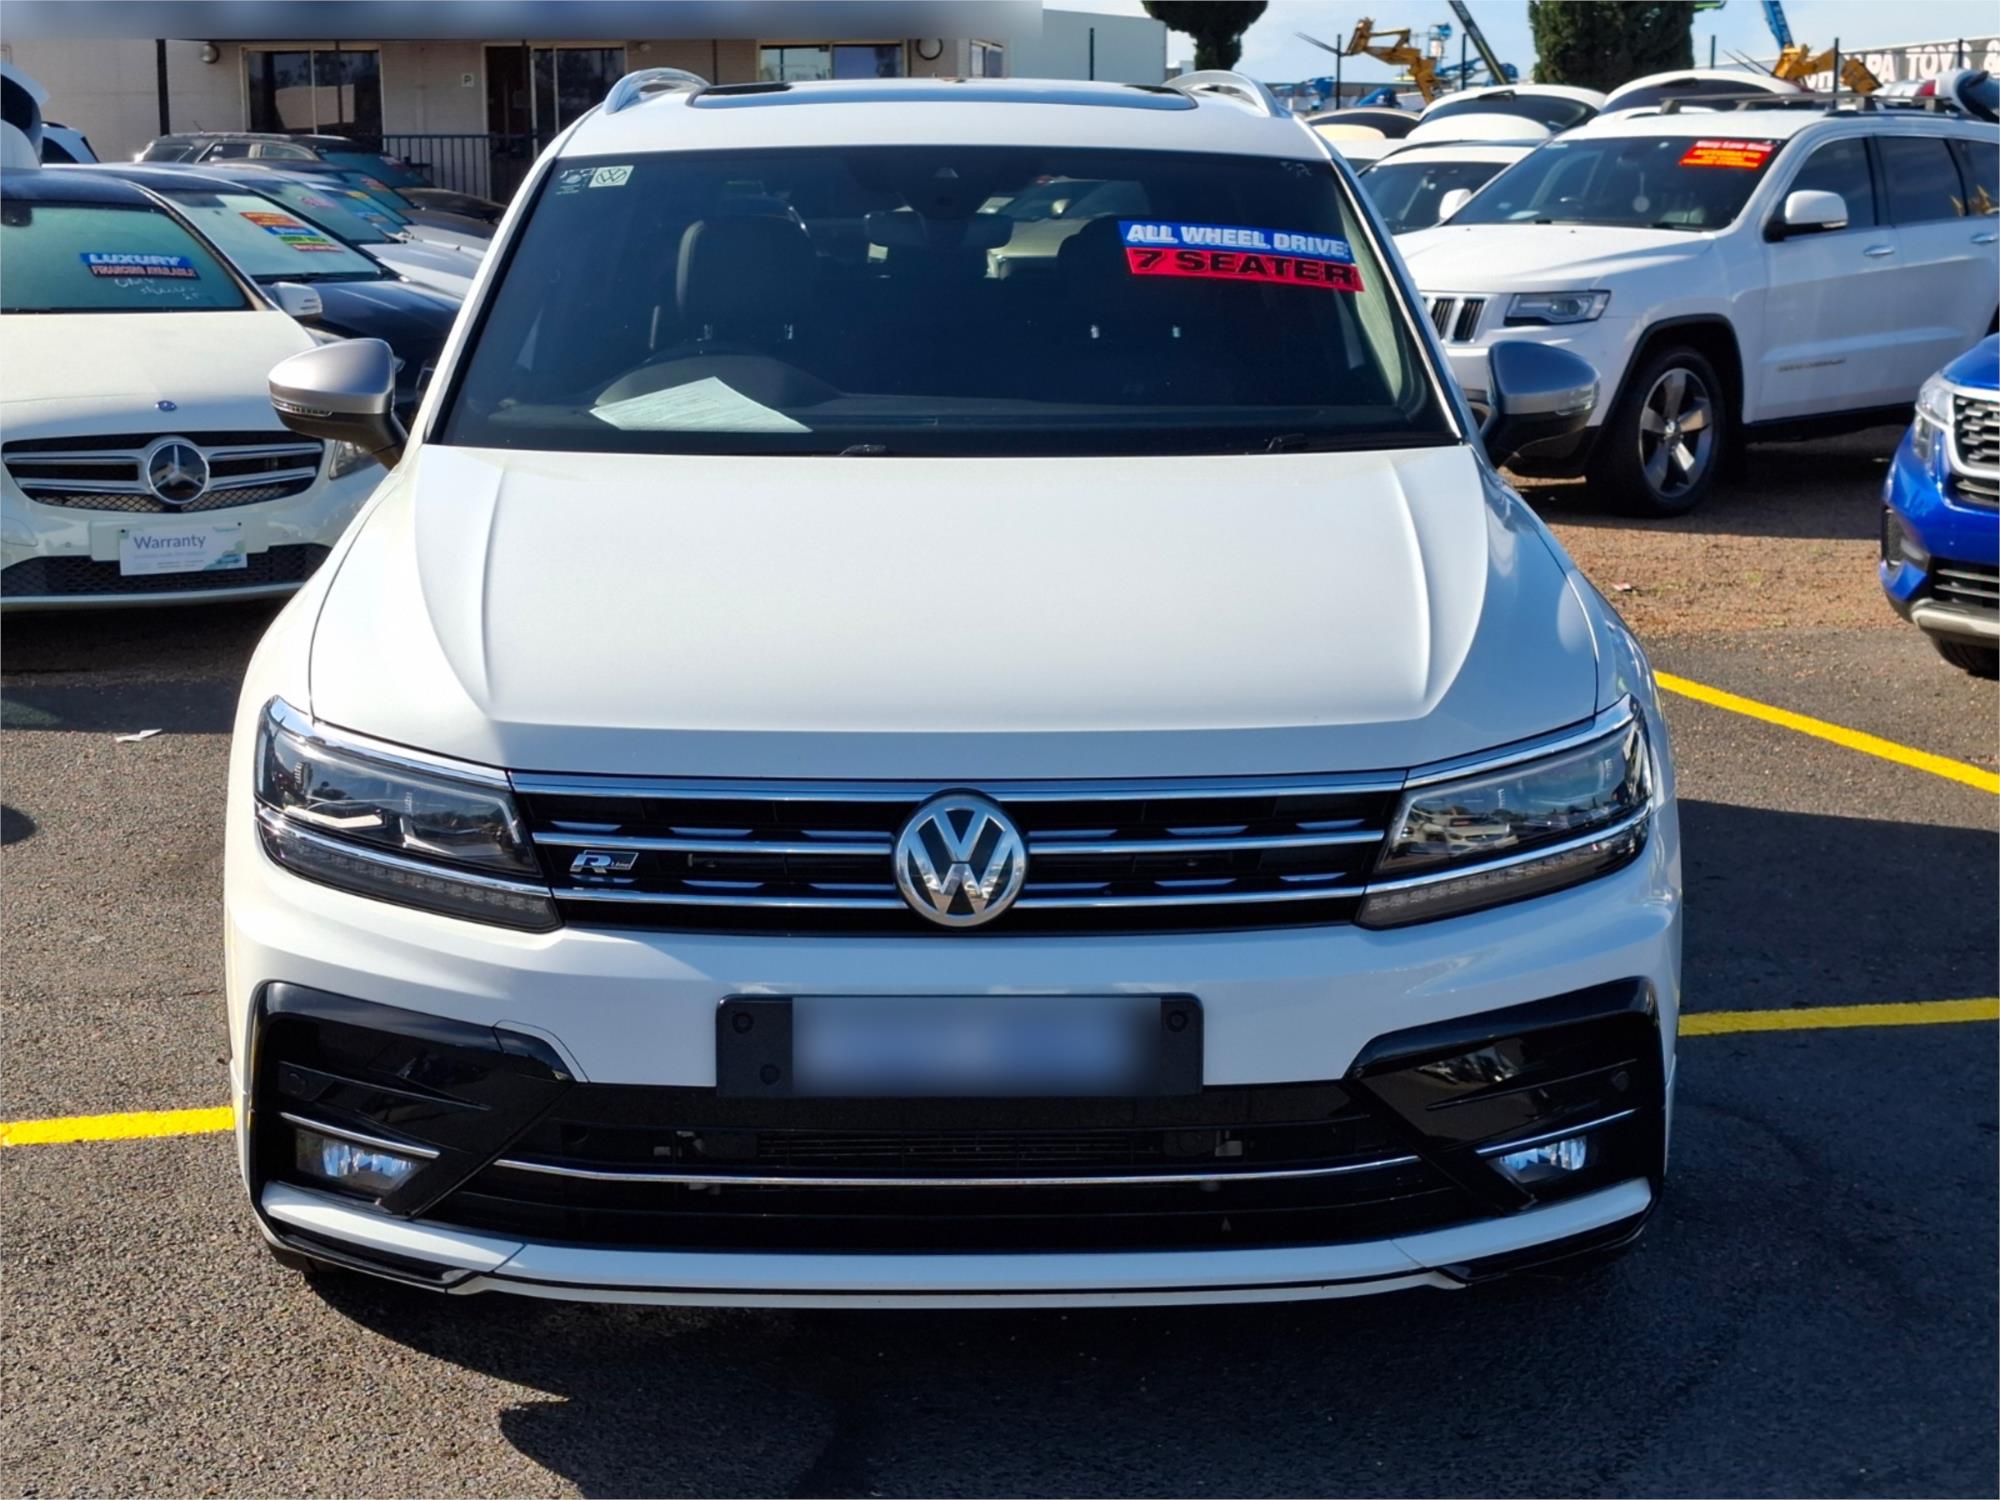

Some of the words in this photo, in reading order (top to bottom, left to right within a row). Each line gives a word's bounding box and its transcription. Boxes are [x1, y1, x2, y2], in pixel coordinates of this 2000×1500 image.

[1127, 225, 1178, 244] ALL
[1181, 226, 1271, 249] WHEEL
[1273, 232, 1350, 259] DRIVE
[88, 253, 180, 266] LUXURY
[1134, 250, 1172, 271] 7
[1175, 250, 1356, 285] SEATER
[133, 534, 206, 550] Warranty
